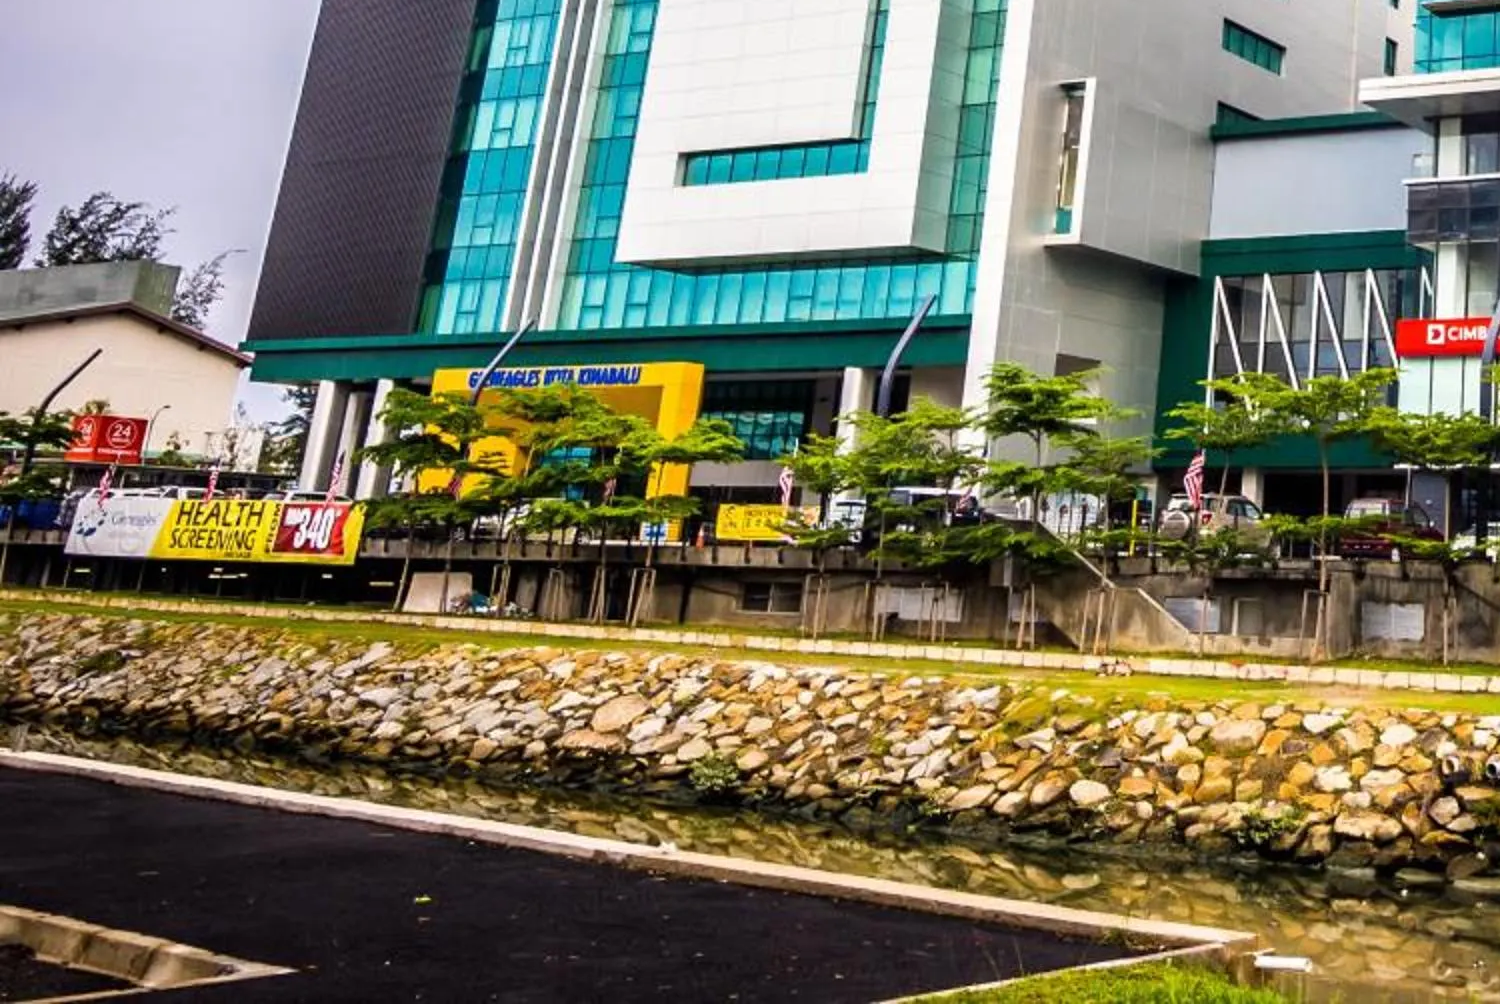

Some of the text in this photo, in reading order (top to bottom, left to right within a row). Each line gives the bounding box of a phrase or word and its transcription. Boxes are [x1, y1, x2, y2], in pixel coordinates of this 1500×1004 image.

[1447, 324, 1488, 342] CIMB
[469, 370, 541, 388] GNEAGLES
[111, 423, 132, 437] 24
[175, 501, 267, 528] HEALTH
[168, 527, 257, 551] SCREENING
